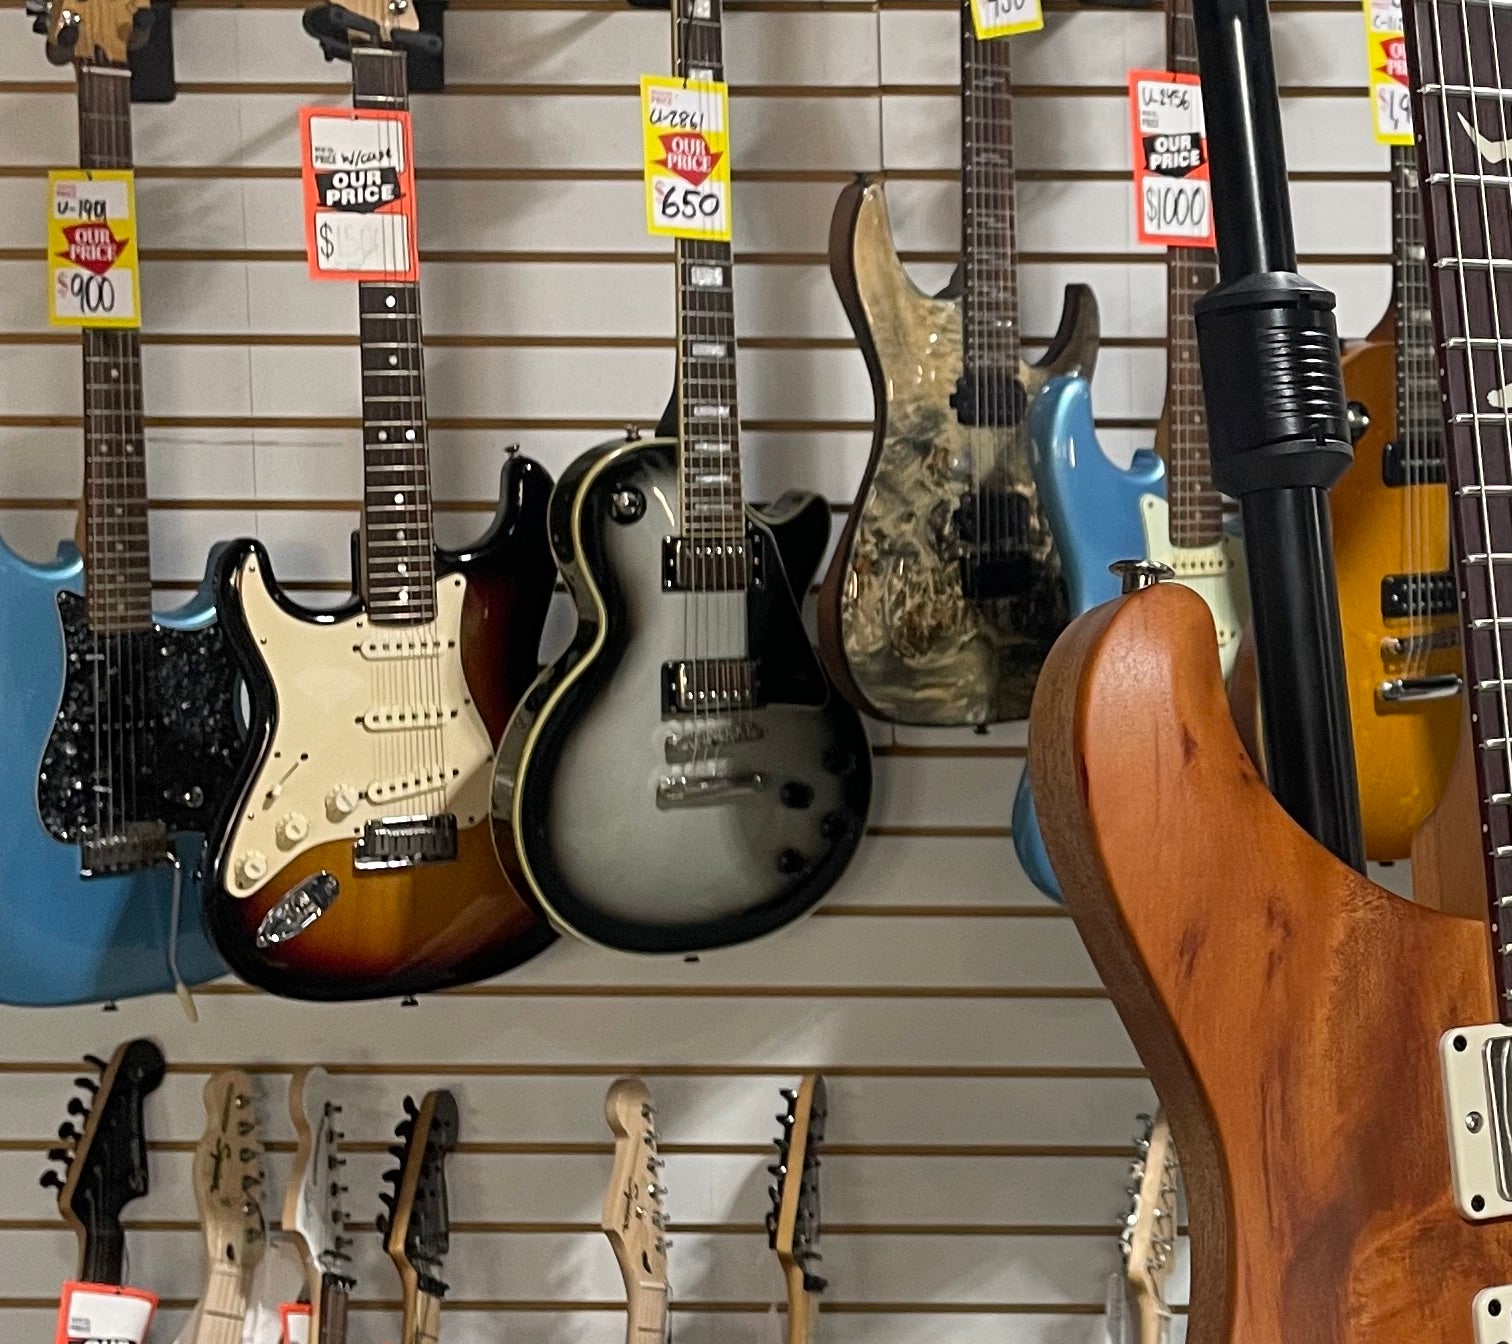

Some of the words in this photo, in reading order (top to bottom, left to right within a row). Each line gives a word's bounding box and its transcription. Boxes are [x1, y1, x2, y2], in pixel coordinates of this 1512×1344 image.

[672, 136, 706, 154] OUR
[1154, 135, 1191, 153] OUR
[666, 152, 711, 173] PRICE
[1150, 151, 1200, 170] PRICE
[332, 170, 381, 188] OUR
[326, 184, 395, 206] PRICE
[1146, 187, 1206, 229] $1000
[75, 227, 110, 244] OUR
[69, 244, 117, 262] PRICE
